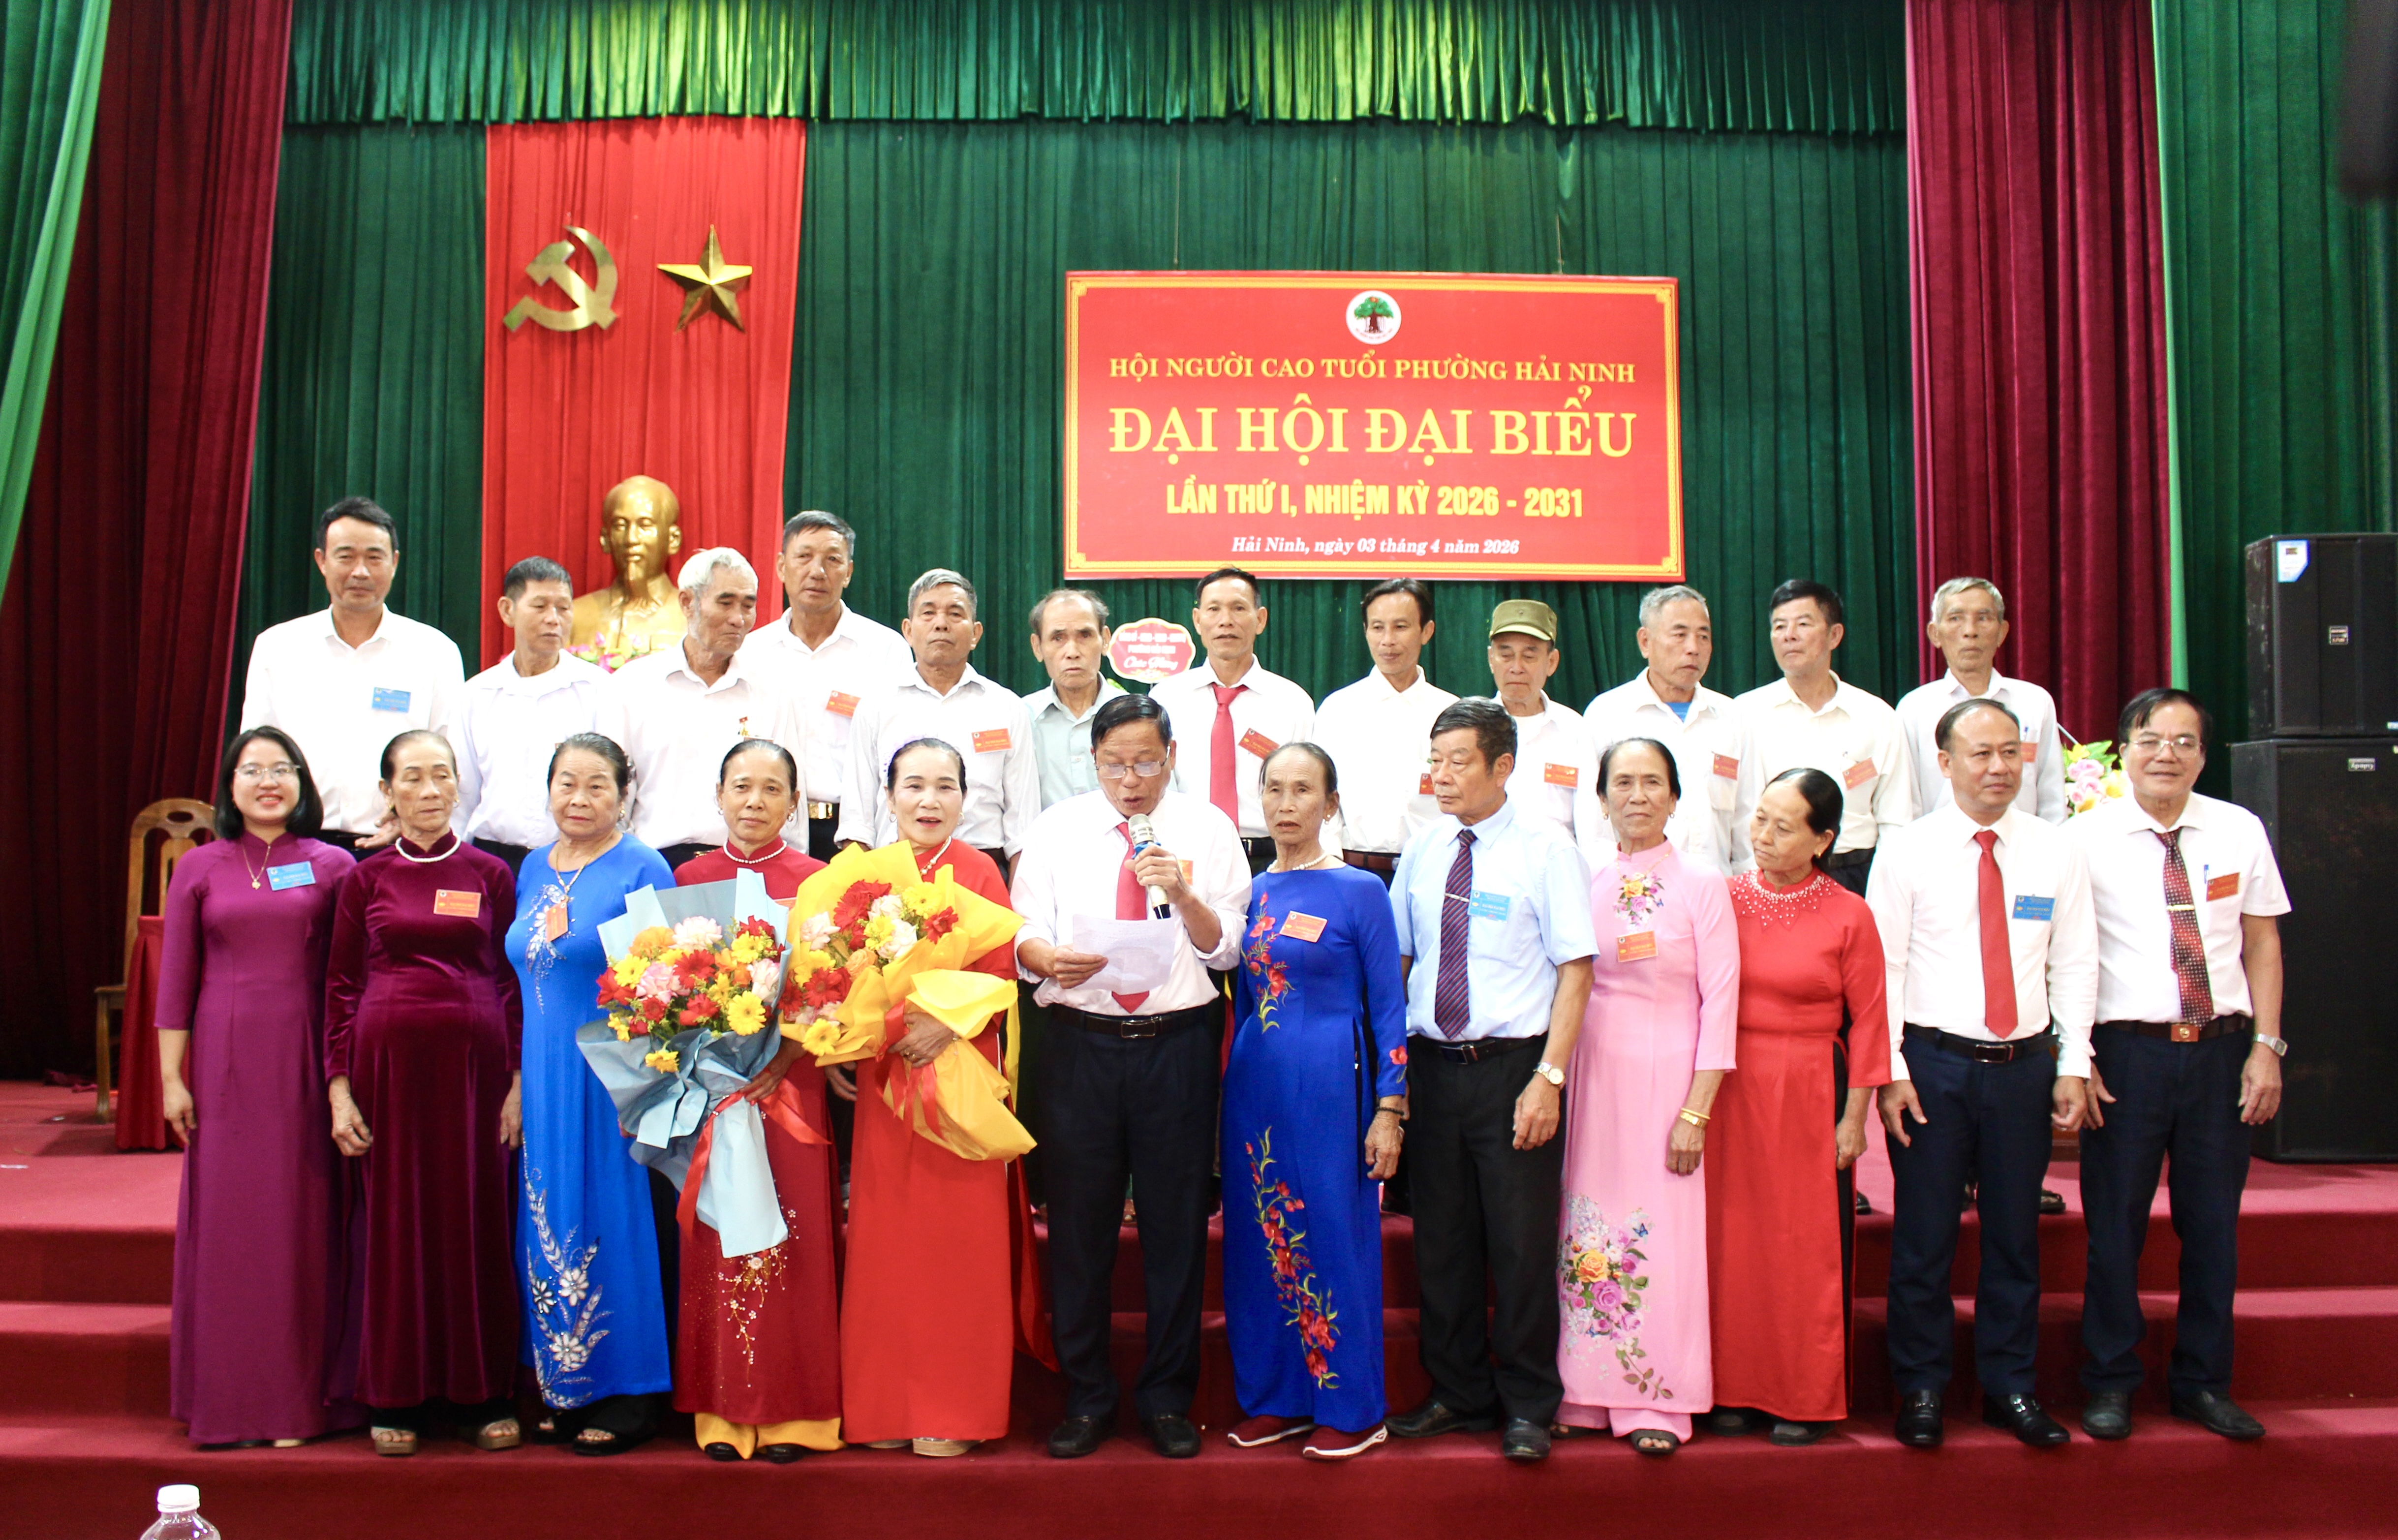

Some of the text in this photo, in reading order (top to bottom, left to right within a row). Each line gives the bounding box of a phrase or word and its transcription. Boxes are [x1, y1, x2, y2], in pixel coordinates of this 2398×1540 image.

[1110, 349, 1634, 382] HỘI NGƯỜI CAO TUỔI PHƯỜNG HẢI NINH
[1108, 385, 1637, 466] ĐẠI HỘI ĐẠI BIỂU
[1167, 474, 1217, 514] LẦN
[1224, 478, 1277, 514] THỨ
[1281, 484, 1297, 518] I,
[1305, 478, 1389, 521] NHIỆM
[1397, 479, 1430, 515] KỲ
[1437, 486, 1499, 516] 2026
[1524, 487, 1582, 518] 2031
[1231, 535, 1520, 556] Hải Ninh, ngày 03 tháng 4 năm 2026
